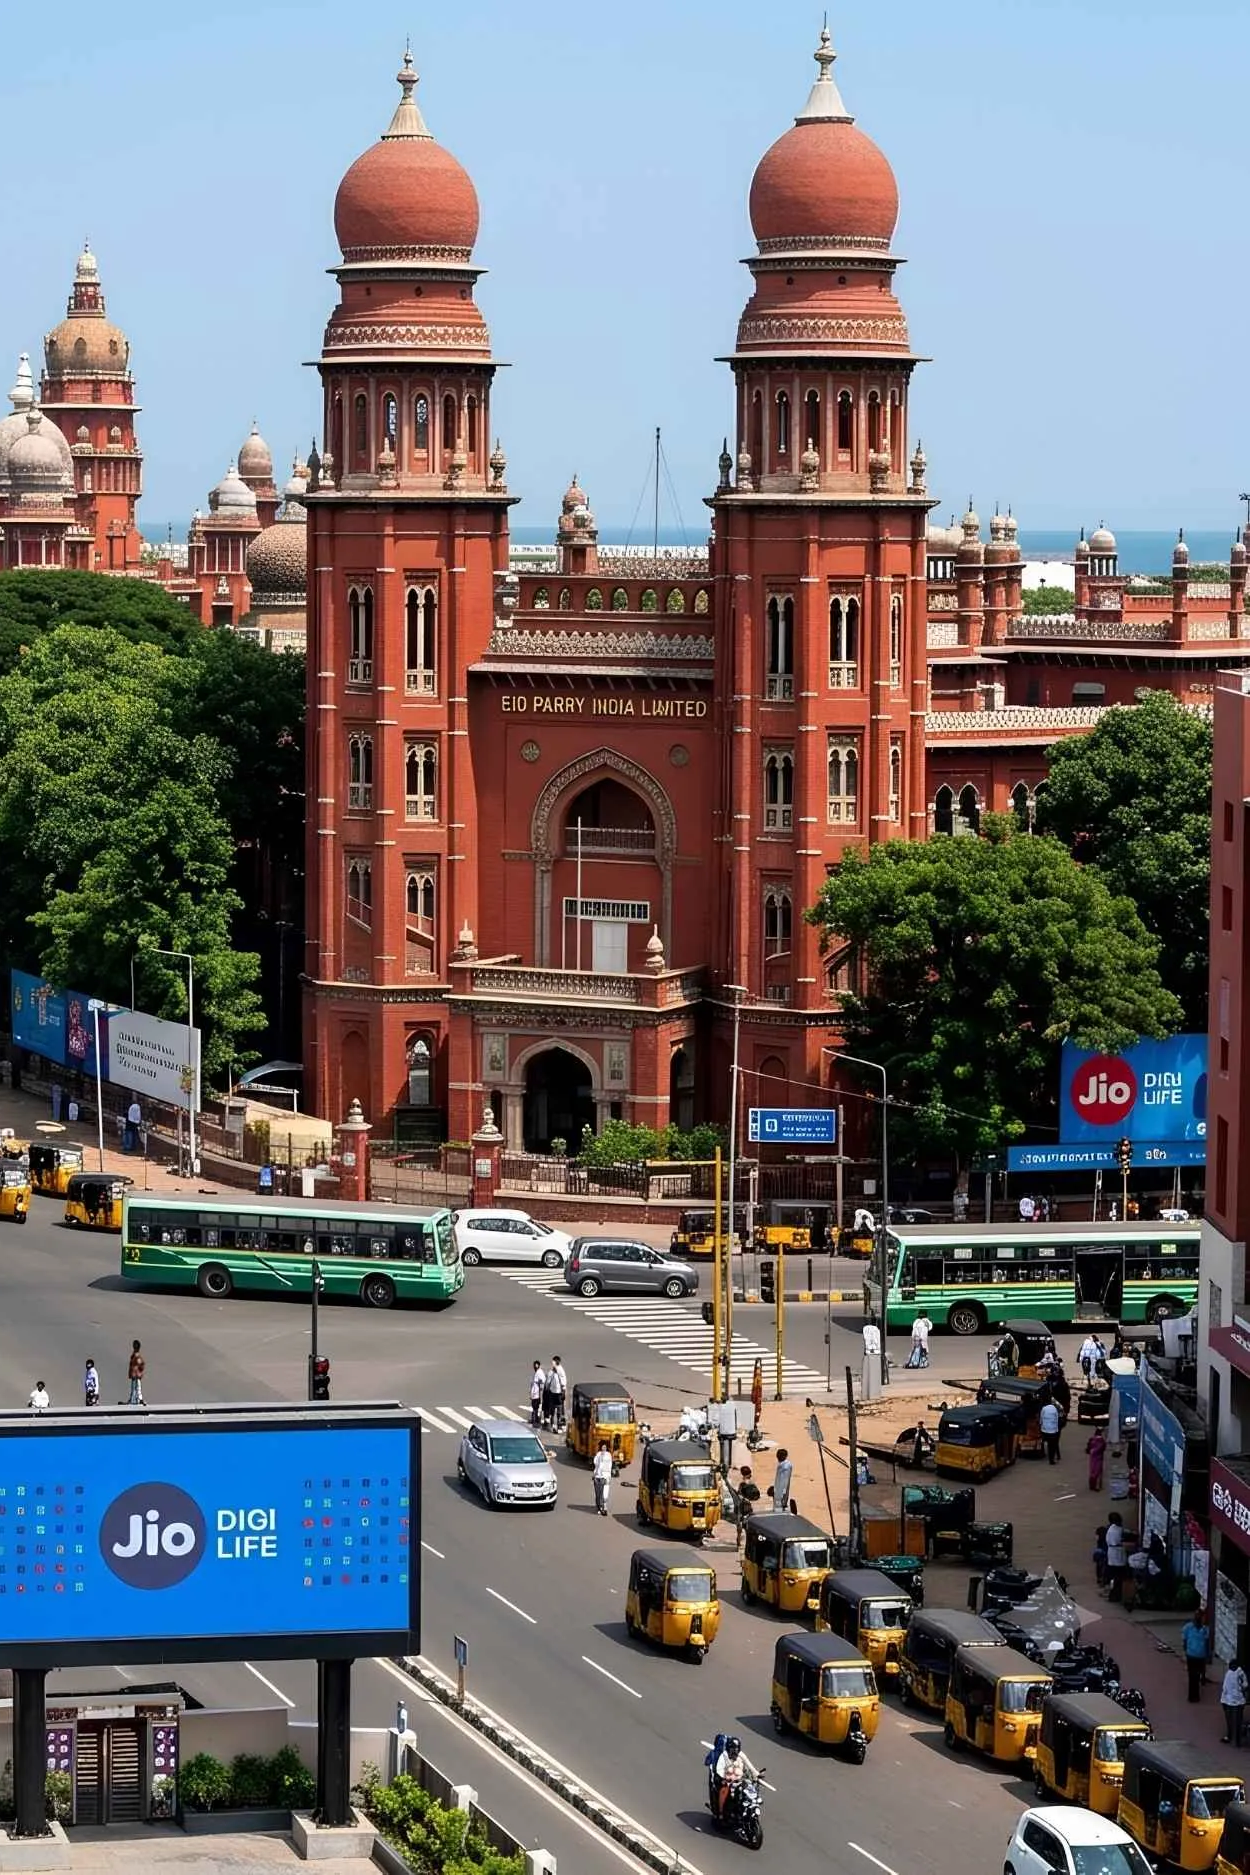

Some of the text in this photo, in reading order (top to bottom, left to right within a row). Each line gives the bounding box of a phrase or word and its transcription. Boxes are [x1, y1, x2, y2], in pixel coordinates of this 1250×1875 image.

[533, 696, 585, 713] PARRY
[592, 698, 635, 715] INDIA
[1079, 1072, 1131, 1105] Jio
[217, 1508, 276, 1532] DIGI
[112, 1509, 196, 1558] Jio
[217, 1535, 278, 1559] LIFE
